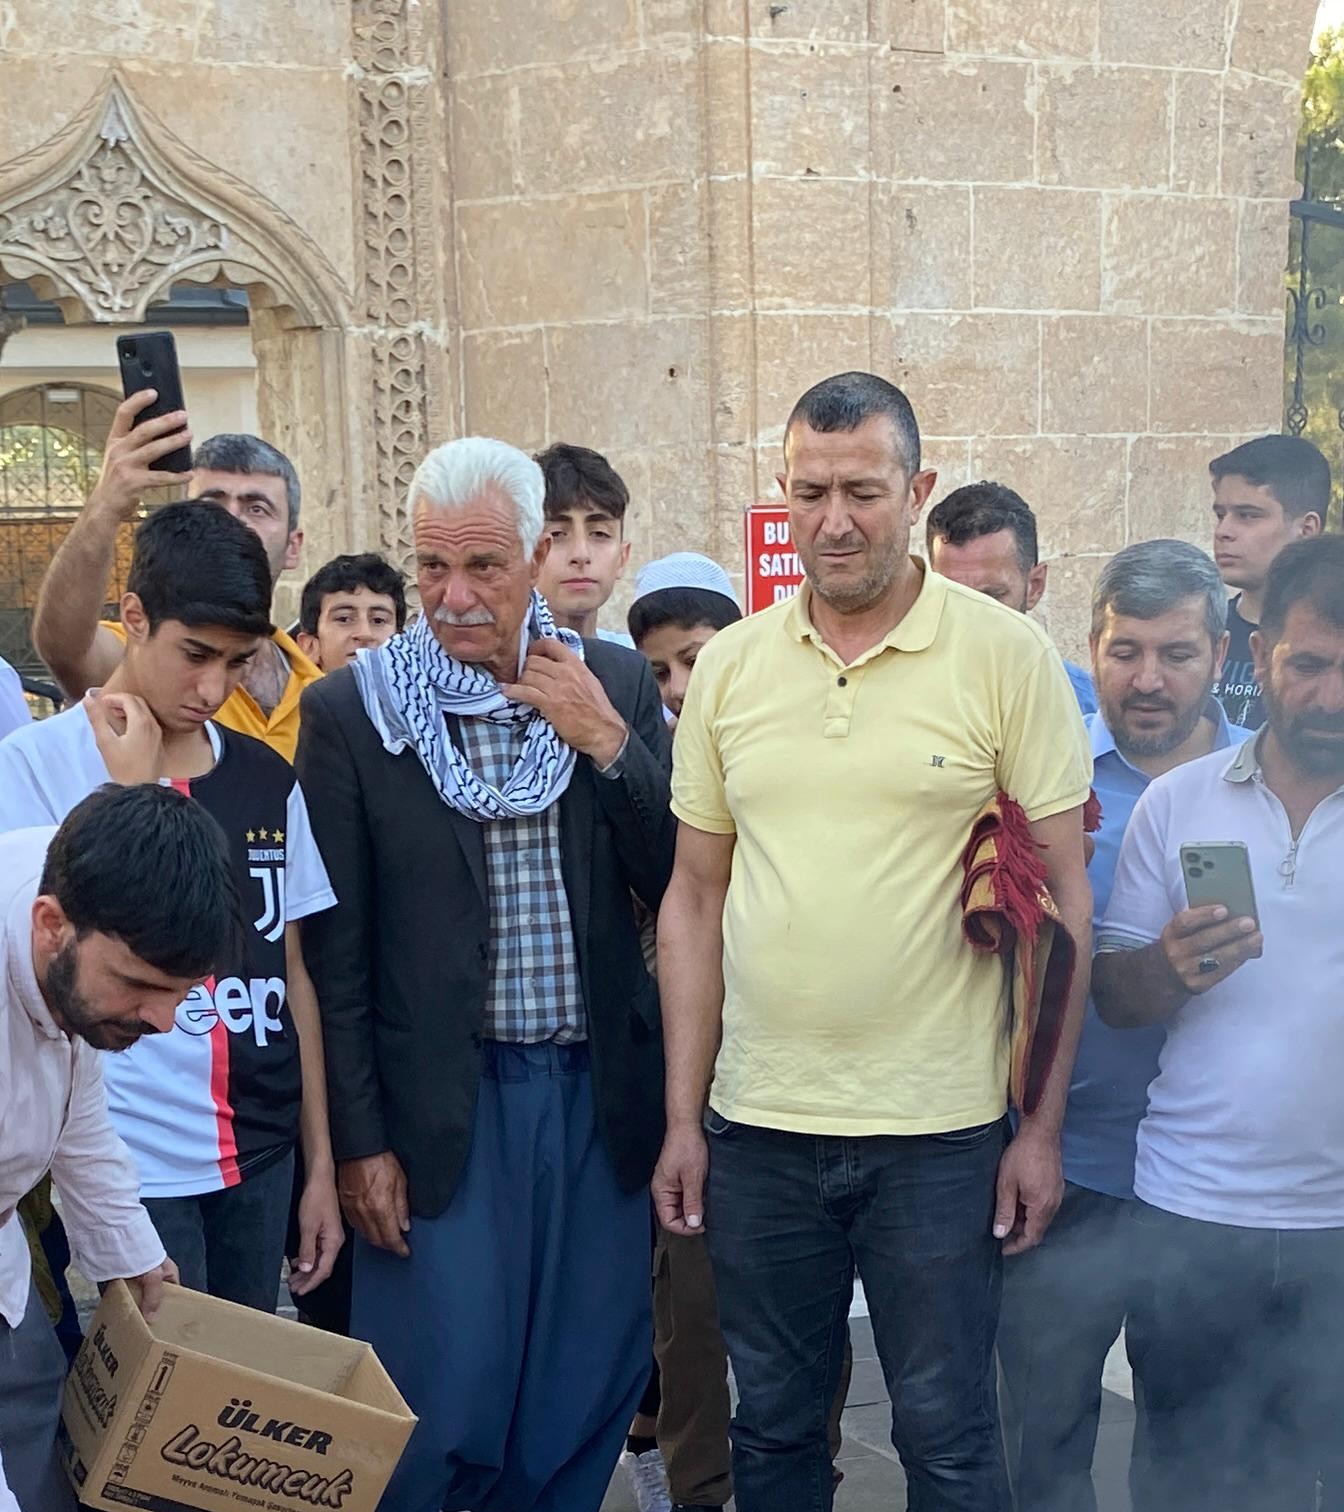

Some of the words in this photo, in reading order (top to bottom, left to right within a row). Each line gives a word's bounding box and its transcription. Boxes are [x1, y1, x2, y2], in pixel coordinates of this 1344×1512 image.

[763, 521, 789, 545] BU
[175, 976, 286, 1047] eep
[217, 1398, 333, 1455] ÜLKER
[161, 1423, 354, 1509] Lokumcuk
